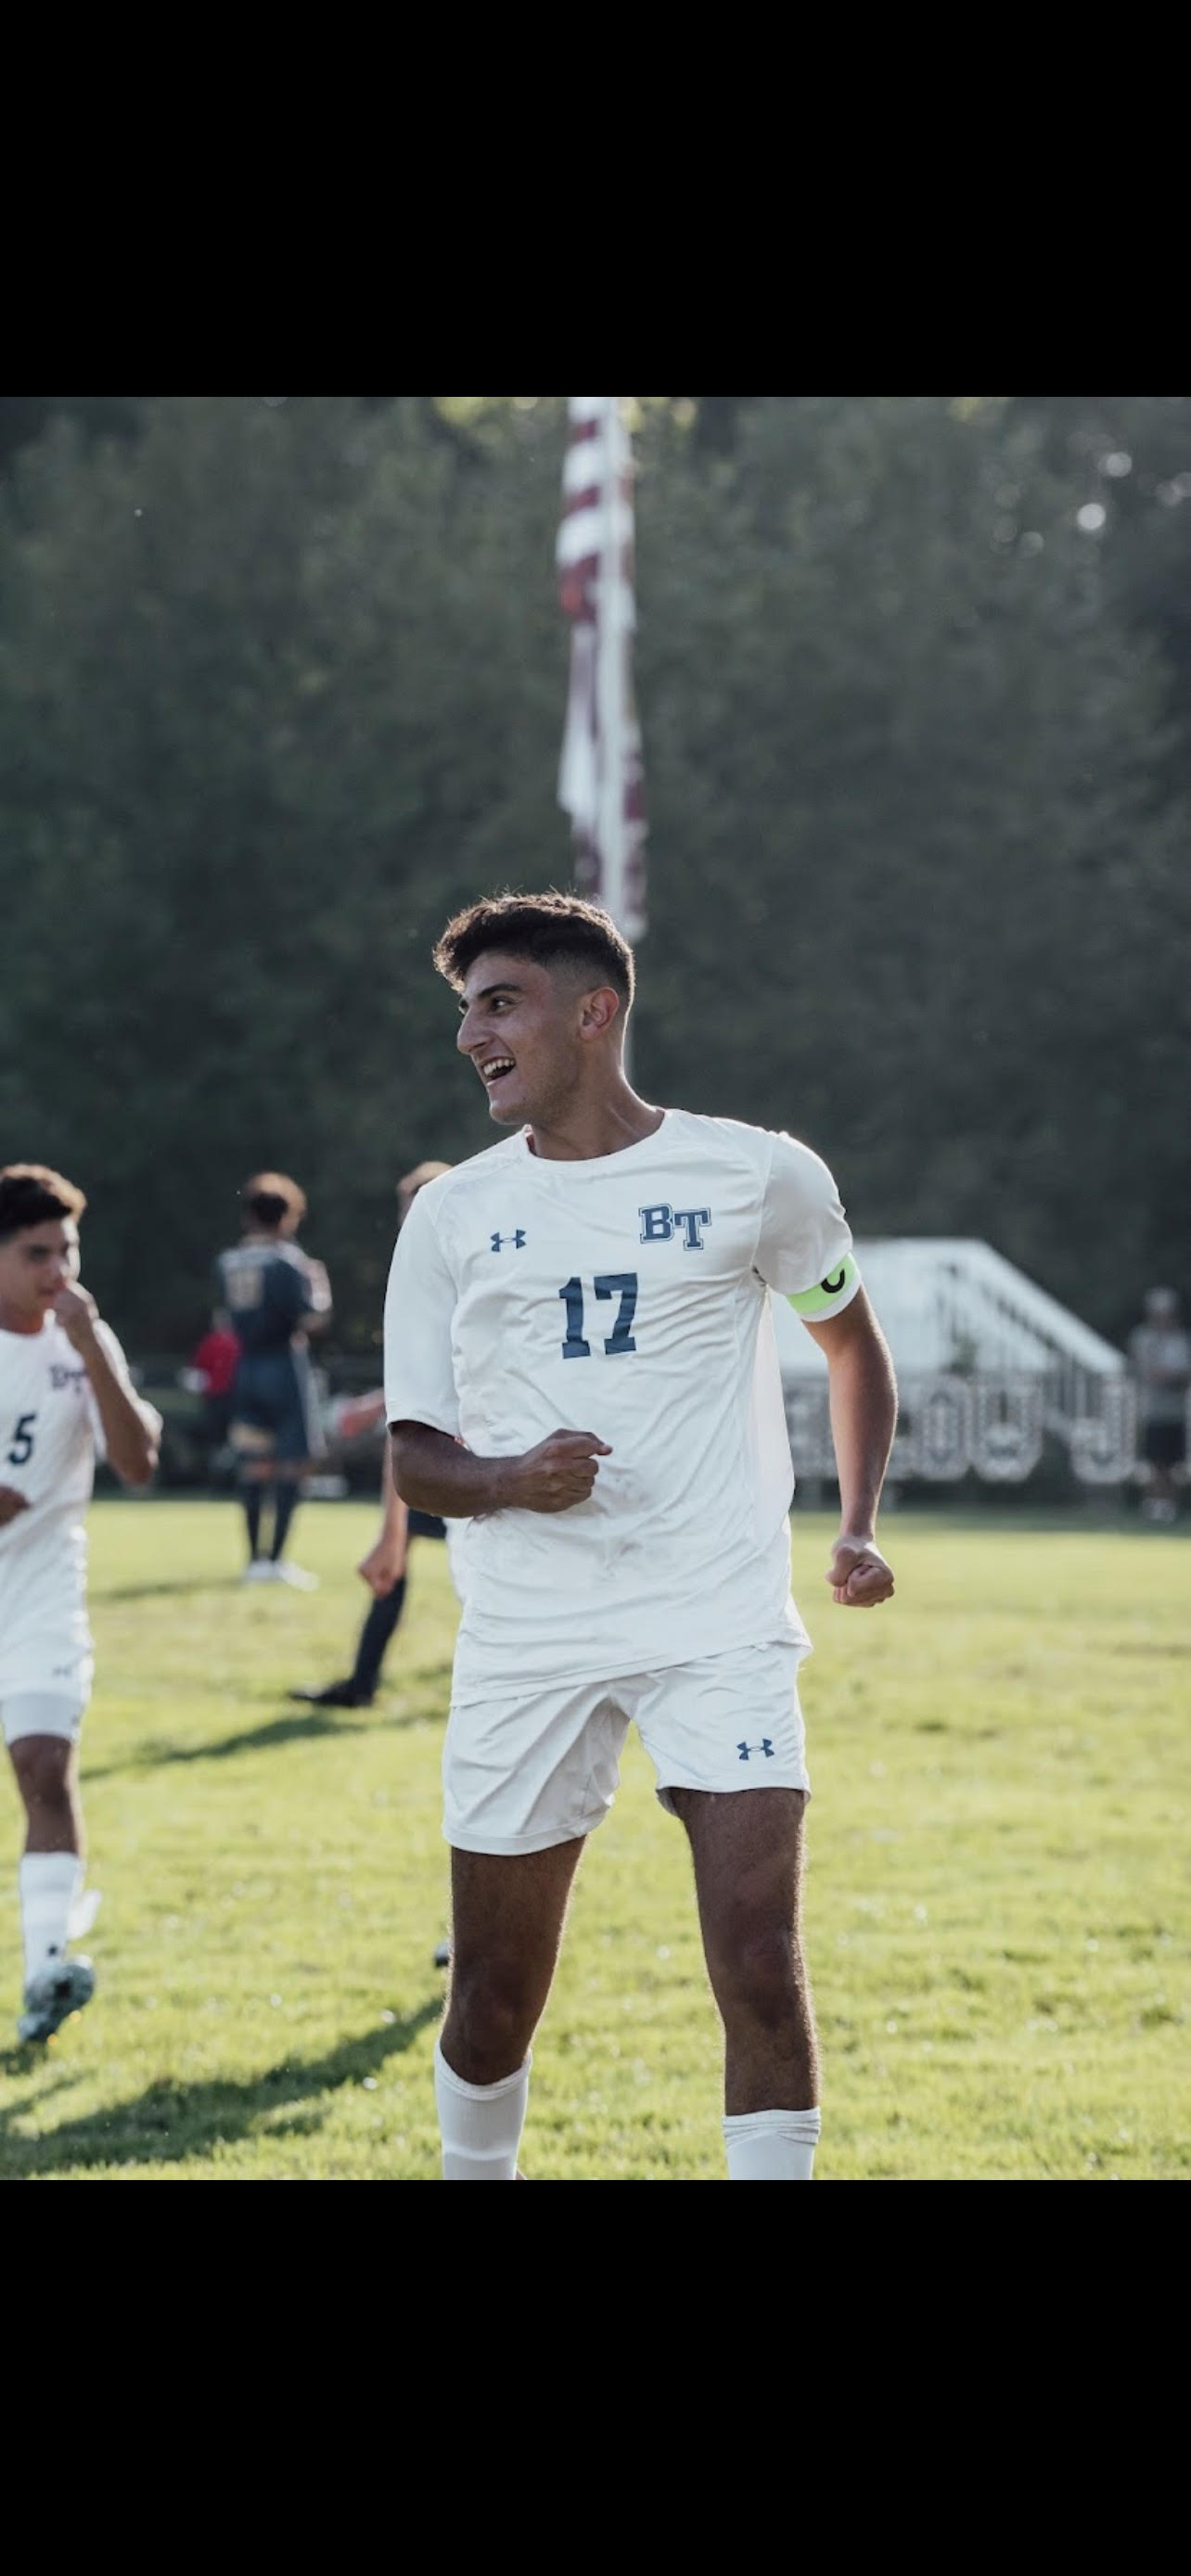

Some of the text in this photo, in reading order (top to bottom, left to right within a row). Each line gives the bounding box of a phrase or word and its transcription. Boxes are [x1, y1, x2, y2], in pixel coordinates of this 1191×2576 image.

[638, 1203, 711, 1251] BT
[558, 1271, 639, 1360] 17
[7, 1410, 37, 1466] 5
